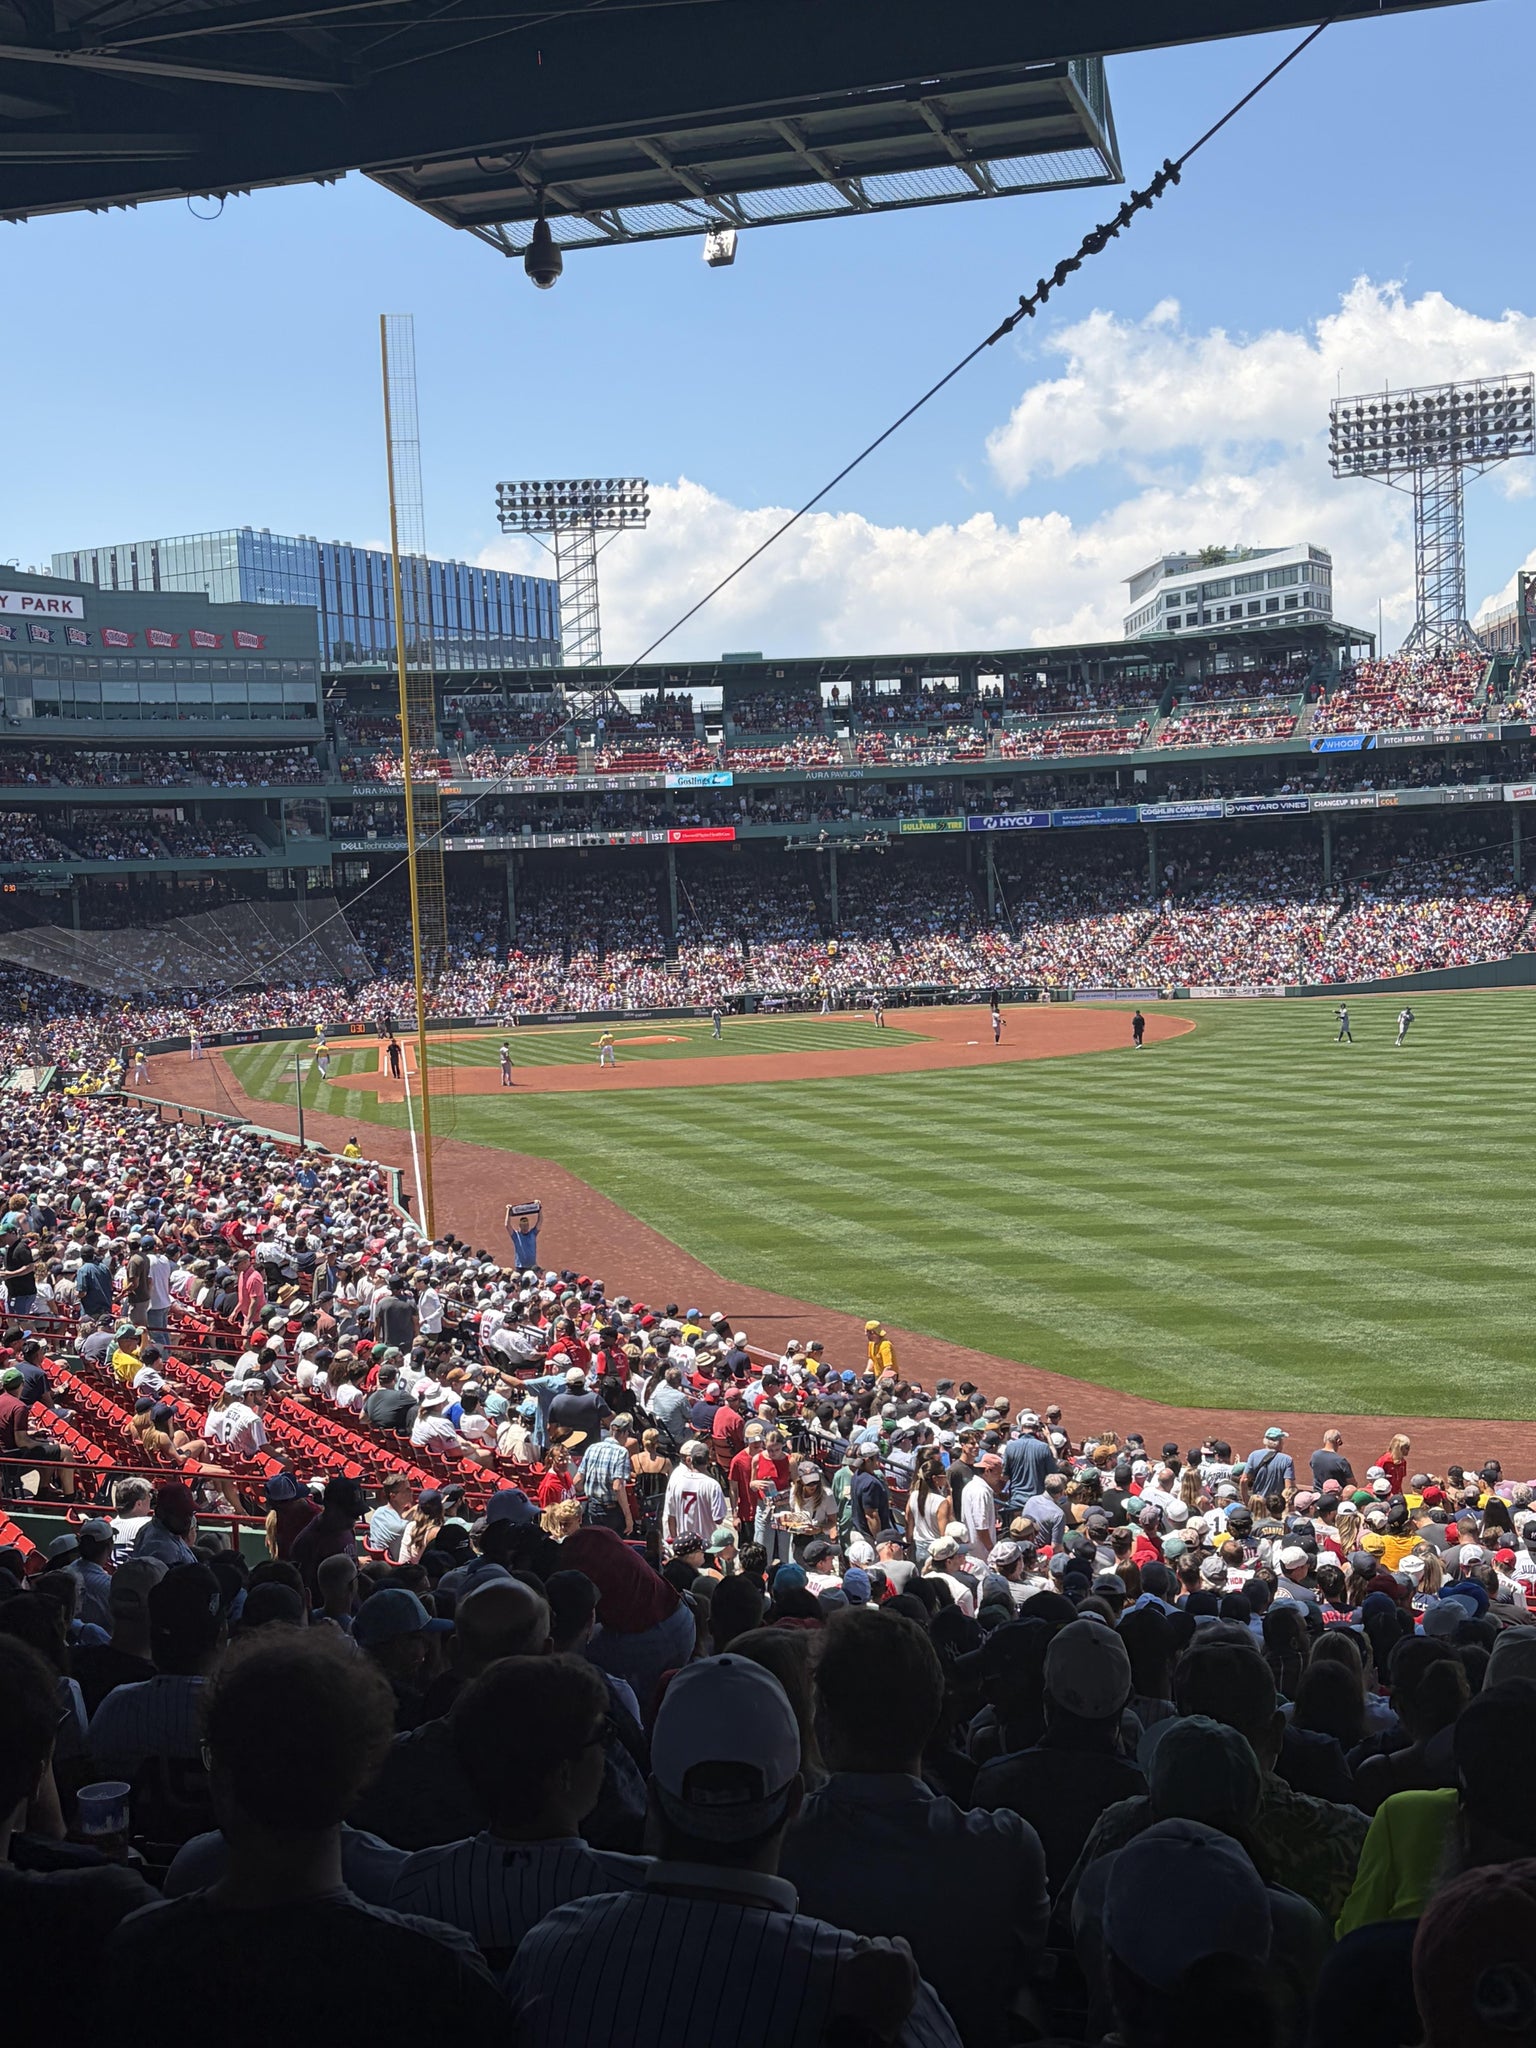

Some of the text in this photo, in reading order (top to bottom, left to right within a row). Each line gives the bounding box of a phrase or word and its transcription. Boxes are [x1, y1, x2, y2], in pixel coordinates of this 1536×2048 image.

[21, 597, 73, 613] PARK
[1327, 740, 1359, 748] WHOOP
[1404, 735, 1425, 743] BREAK
[830, 769, 864, 779] PAVILION
[678, 777, 710, 787] Goslings
[379, 787, 406, 795] PAVILIO
[1235, 801, 1308, 812] VINEYARD VINES
[1313, 799, 1349, 808] CHANGEUP
[1360, 797, 1374, 805] MPH
[1380, 797, 1399, 806] COLE
[1142, 804, 1221, 815] COGHLIN COMPANIES
[902, 821, 963, 831] SULLIVAN TIRE
[1000, 816, 1033, 827] HYCU
[341, 842, 363, 850] DELL
[363, 841, 409, 851] Technologies
[482, 1324, 491, 1339] 6
[224, 1422, 232, 1442] 2
[681, 1491, 697, 1515] 7
[1321, 1610, 1354, 1625] ORTIZ
